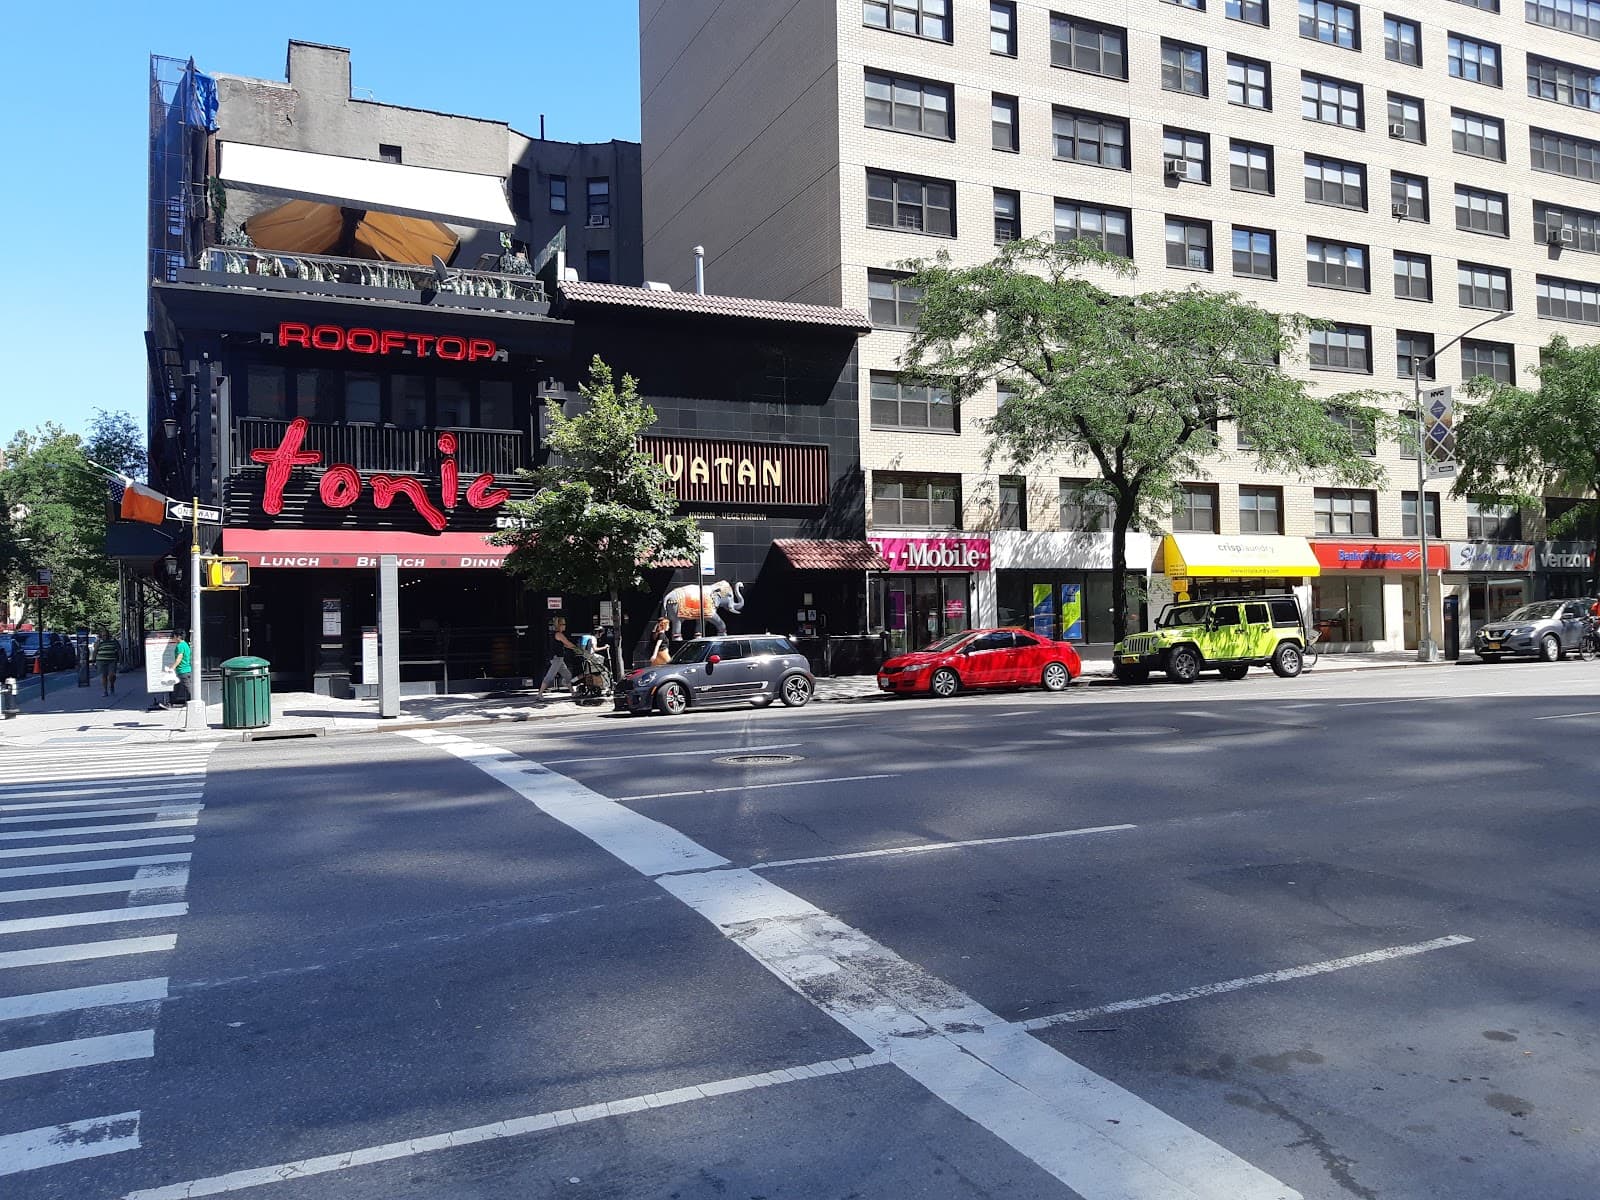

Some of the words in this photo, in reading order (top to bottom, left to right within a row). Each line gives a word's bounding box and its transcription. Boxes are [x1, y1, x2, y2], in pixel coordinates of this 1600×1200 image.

[278, 322, 497, 361] ROOFTOP
[1430, 390, 1445, 398] NYC
[250, 416, 510, 531] tonic
[664, 454, 781, 487] VATAN
[177, 507, 193, 516] ONE
[198, 511, 215, 519] WAY
[688, 511, 716, 519] INDIAN
[721, 512, 767, 521] VEGETARIAN
[1338, 549, 1360, 561] Bank
[1540, 549, 1591, 568] verizon
[260, 556, 320, 567] LUNCH
[356, 556, 425, 567] BRNCH
[460, 557, 509, 568] DINNE
